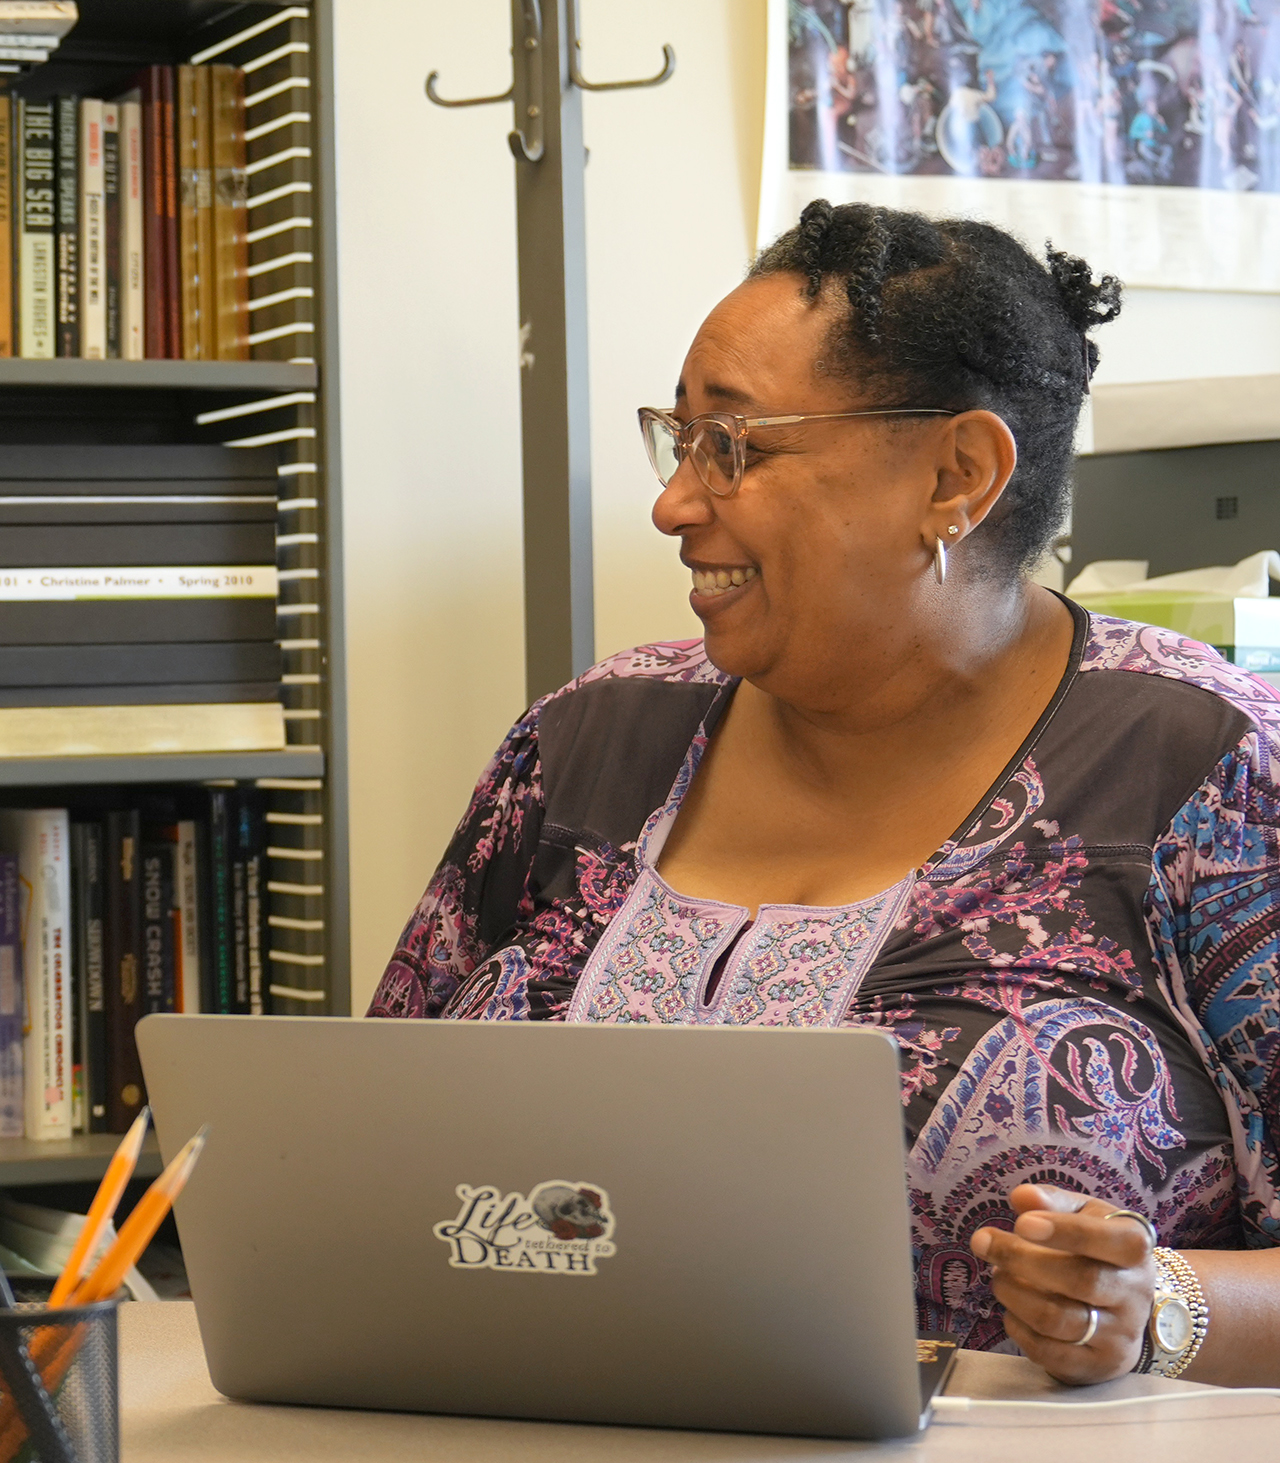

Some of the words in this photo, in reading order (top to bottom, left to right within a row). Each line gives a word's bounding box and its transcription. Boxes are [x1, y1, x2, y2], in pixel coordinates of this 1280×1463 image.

[25, 105, 53, 140] THE
[59, 100, 76, 157] MALCOLM
[25, 147, 53, 181] BIG
[25, 188, 53, 226] SEA
[40, 576, 100, 587] Christine
[104, 576, 150, 587] Palmer
[178, 576, 220, 588] Spring
[147, 858, 163, 919] SNOW
[87, 919, 104, 1011] SHOWDOWN
[147, 926, 163, 995] CRASH
[217, 945, 227, 1004] AMERICAN
[440, 1188, 539, 1248] Life
[453, 1237, 590, 1270] DEATH
[525, 1236, 590, 1251] tethered
[595, 1244, 611, 1252] to
